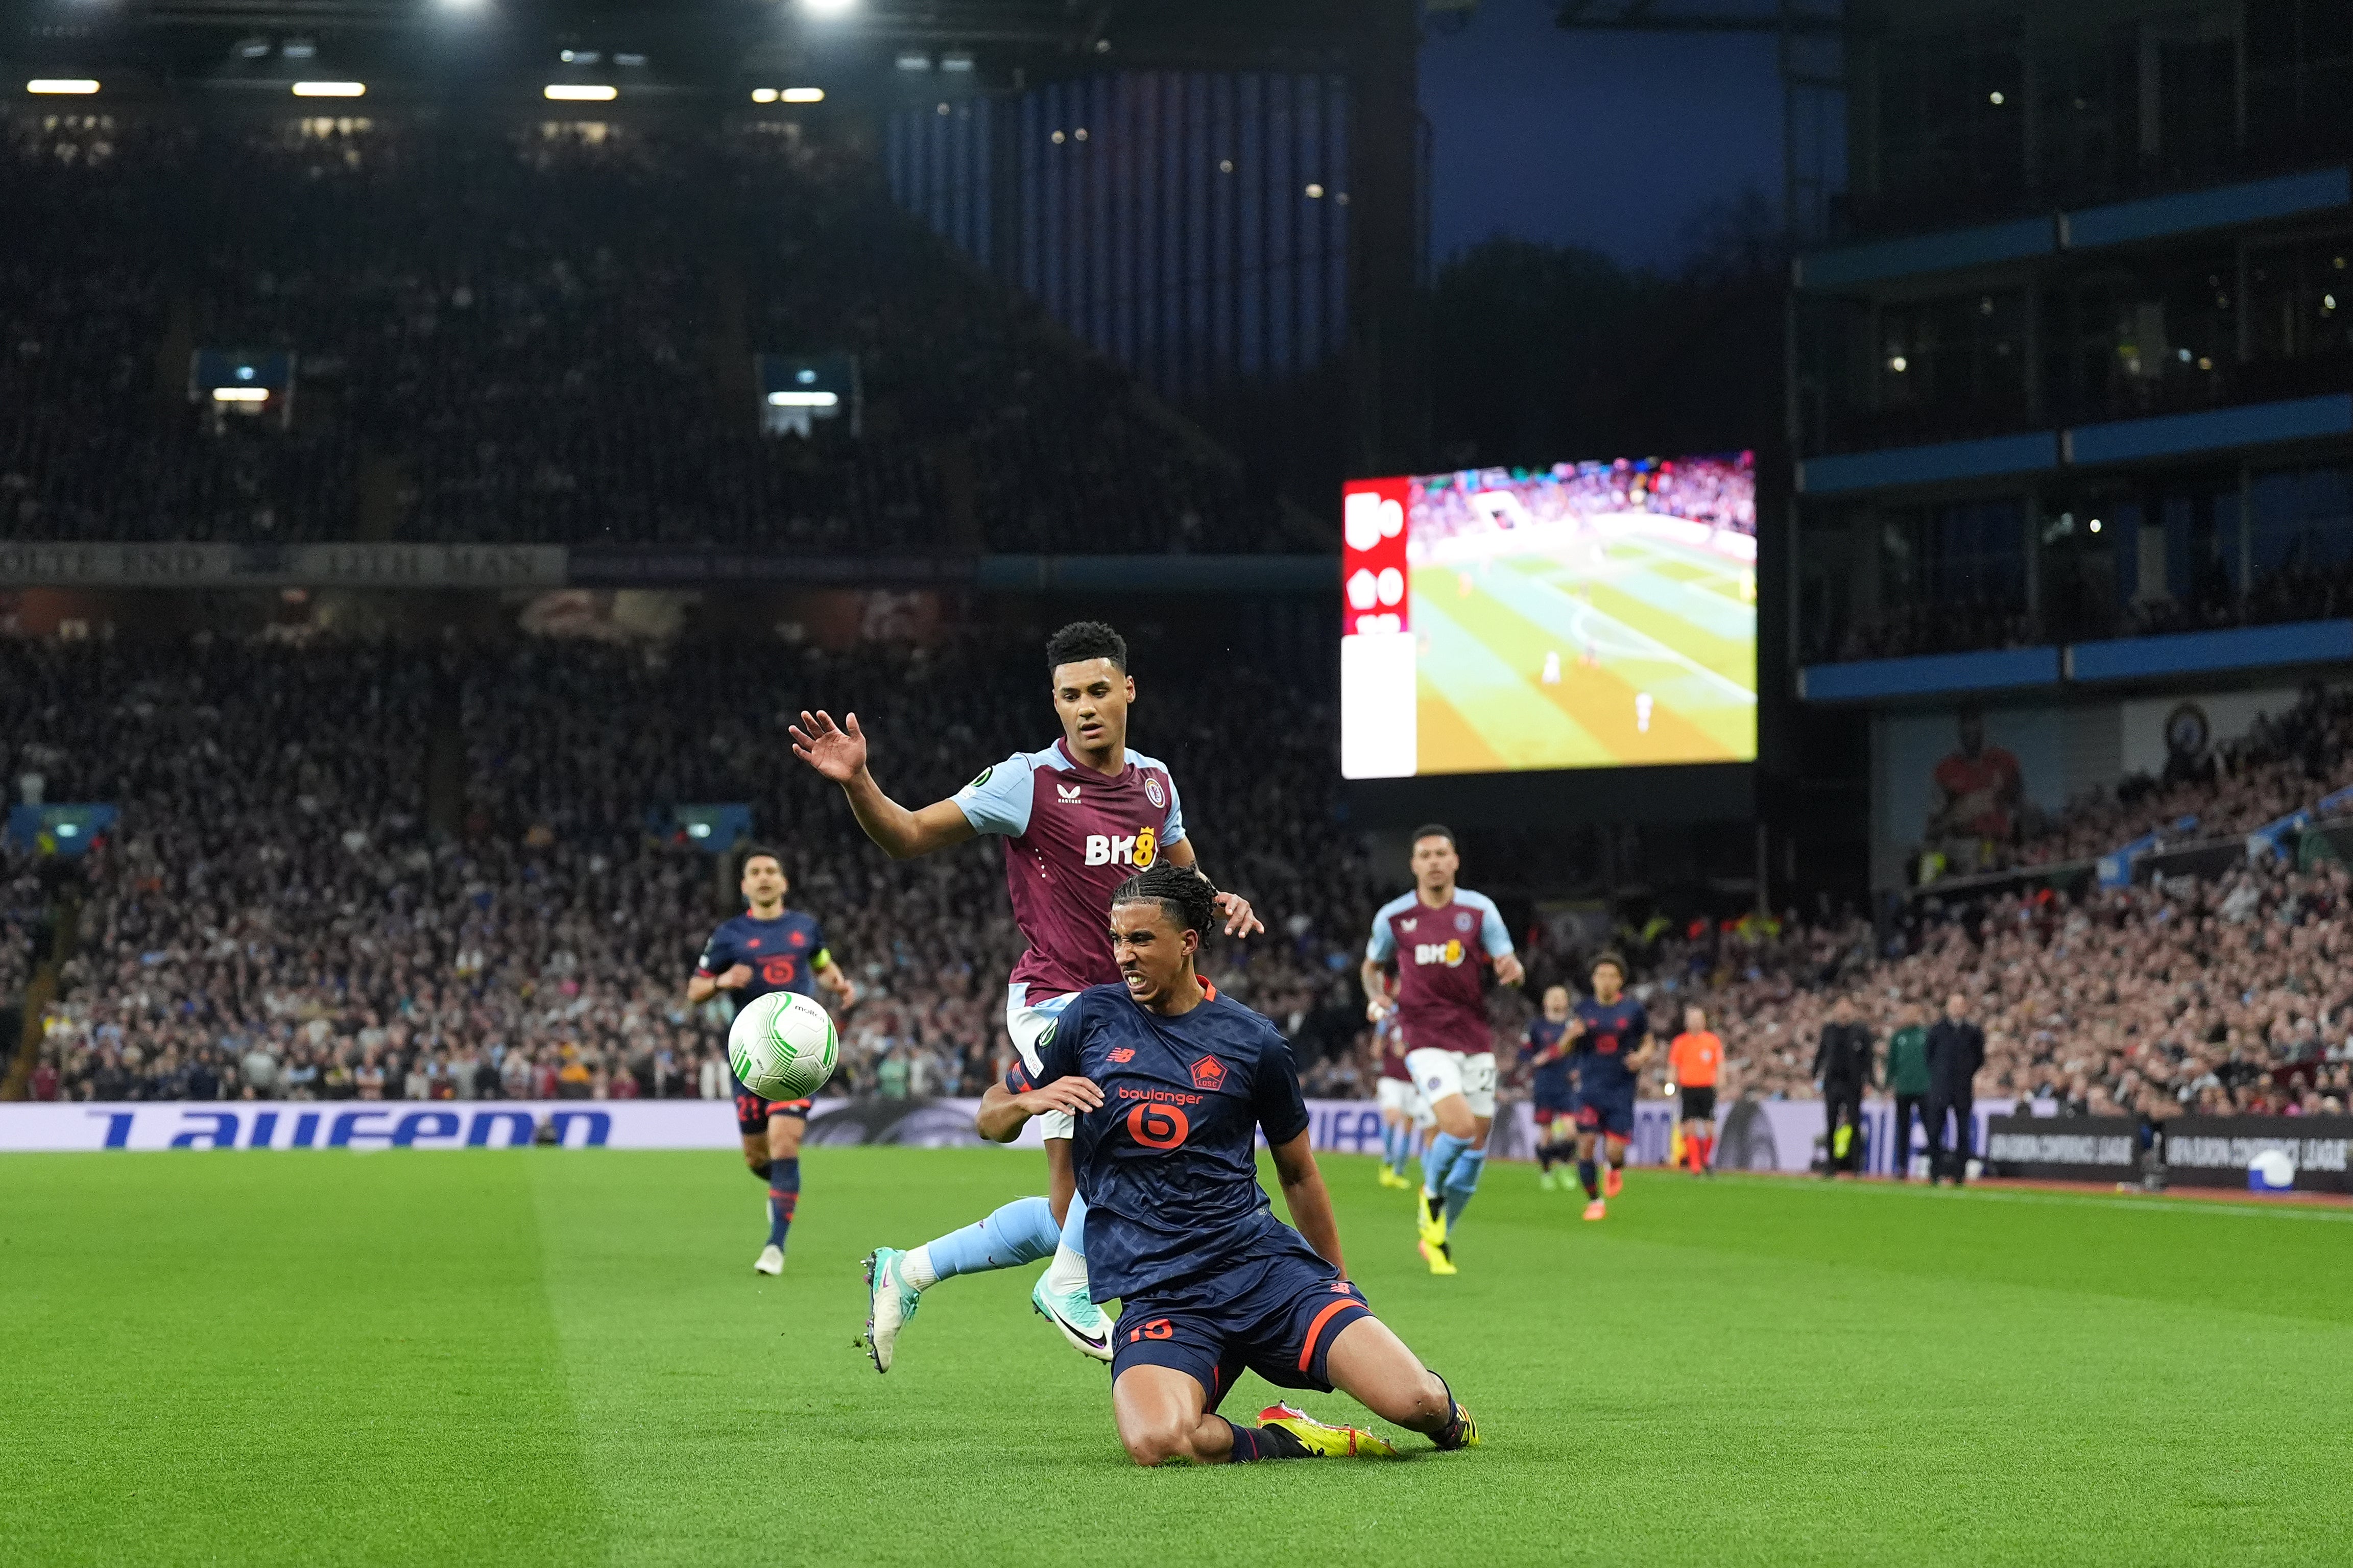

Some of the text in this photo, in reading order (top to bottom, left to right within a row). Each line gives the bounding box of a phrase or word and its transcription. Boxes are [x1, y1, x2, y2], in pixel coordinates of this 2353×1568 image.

[1085, 832, 1158, 872] BK8
[795, 1005, 824, 1023] molten
[1119, 1087, 1204, 1106] boulanger
